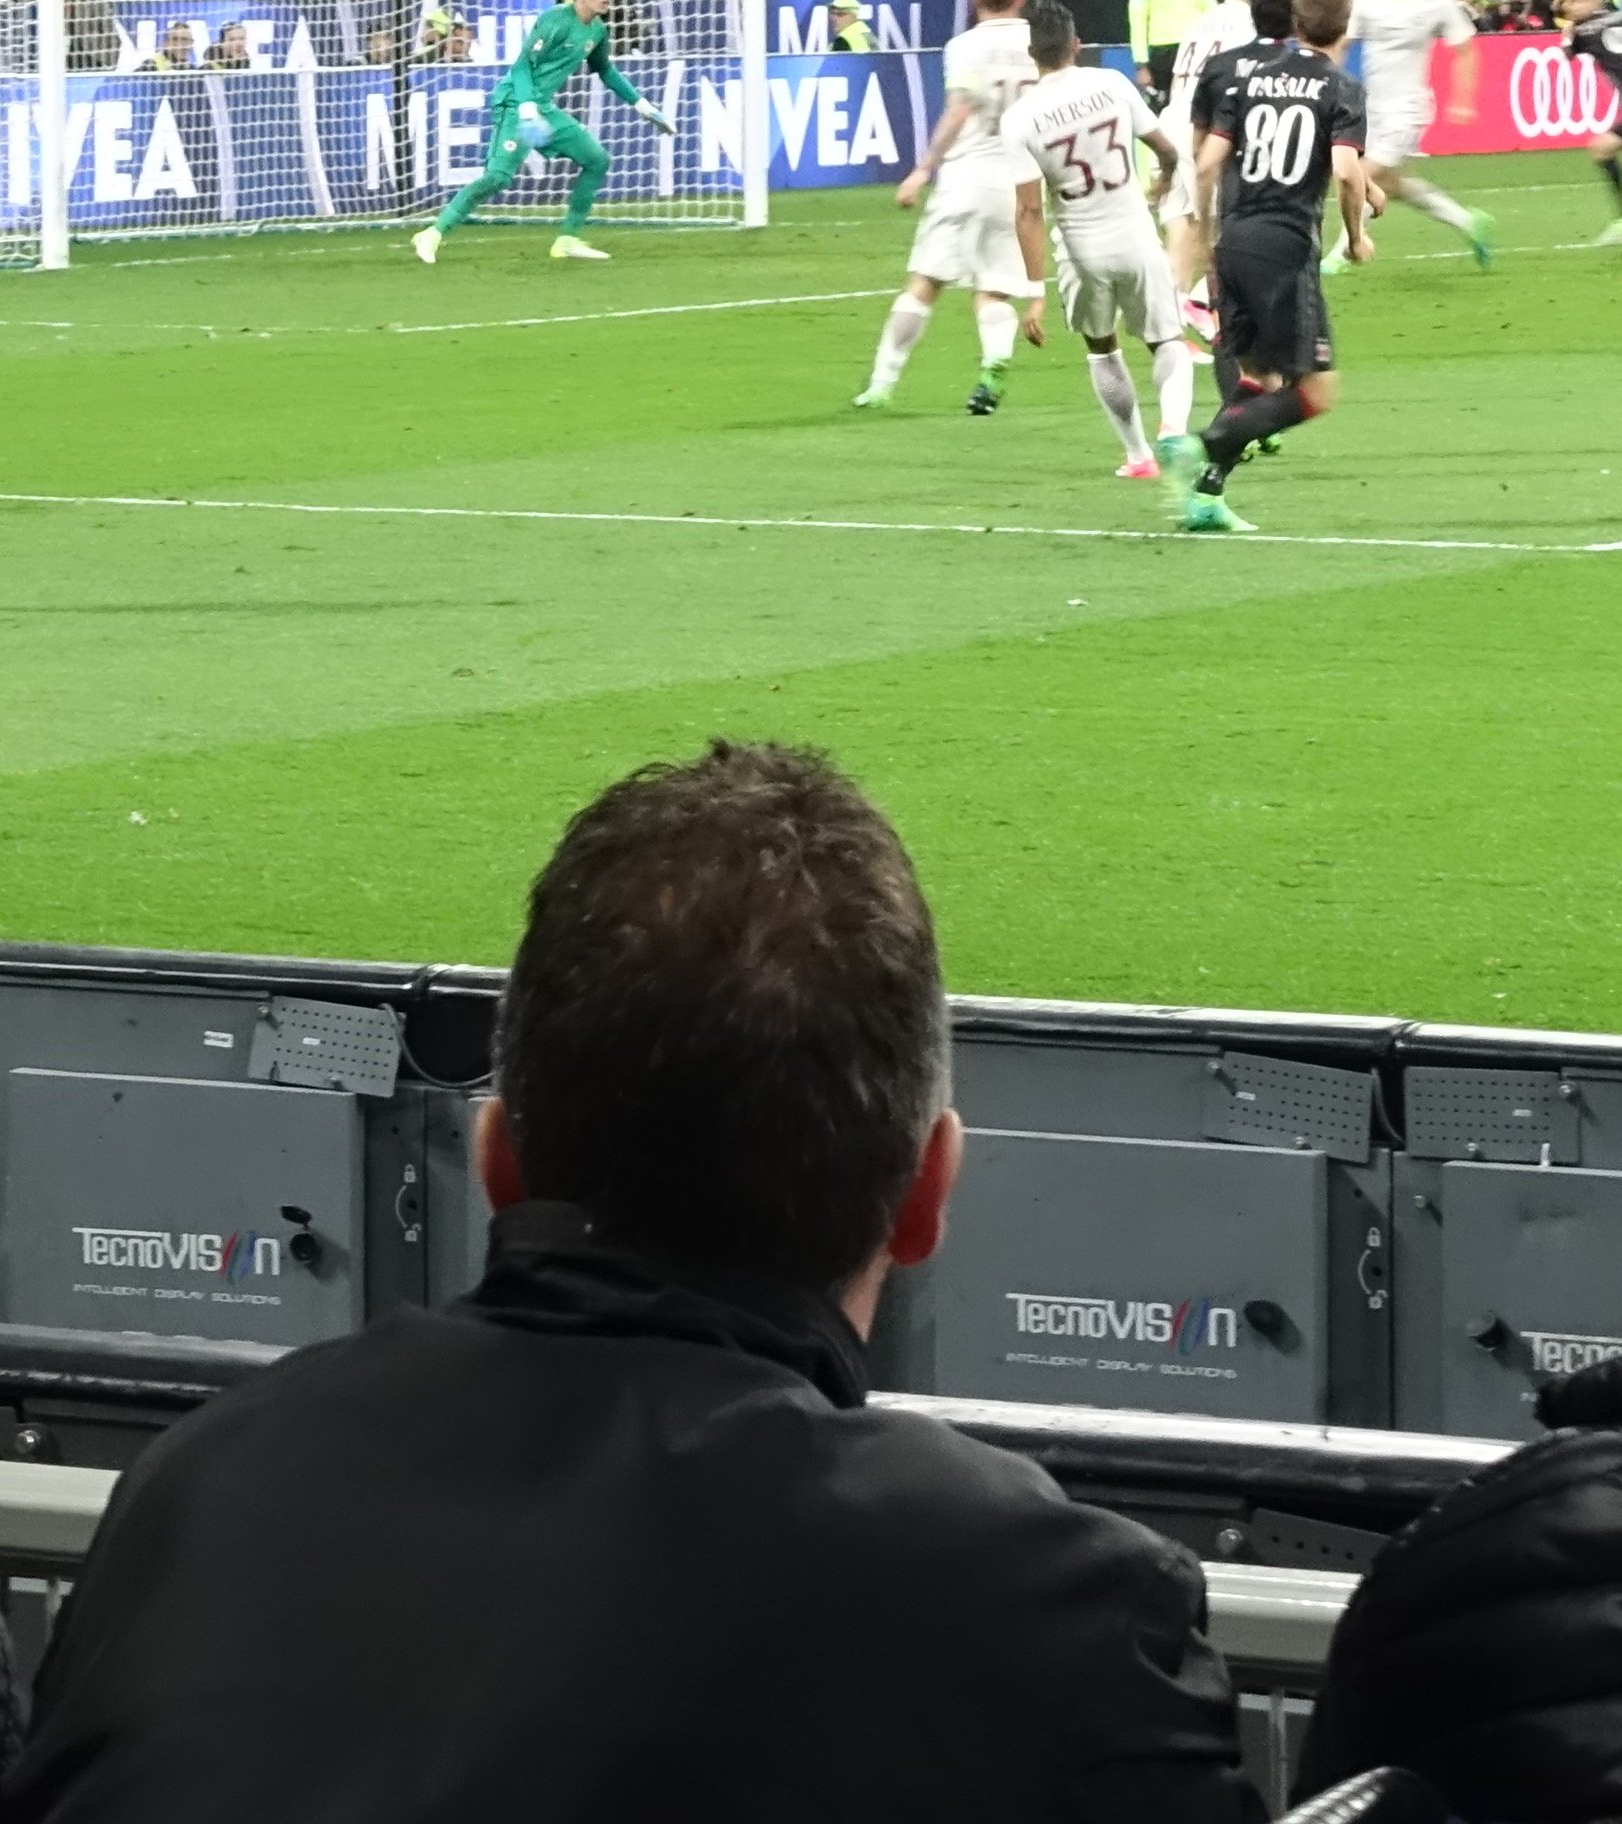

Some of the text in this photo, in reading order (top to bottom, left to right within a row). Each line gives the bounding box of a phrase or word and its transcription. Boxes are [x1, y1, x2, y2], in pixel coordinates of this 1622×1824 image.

[1032, 88, 1116, 134] EMERSON
[1242, 103, 1316, 187] 80
[1045, 116, 1130, 202] 33
